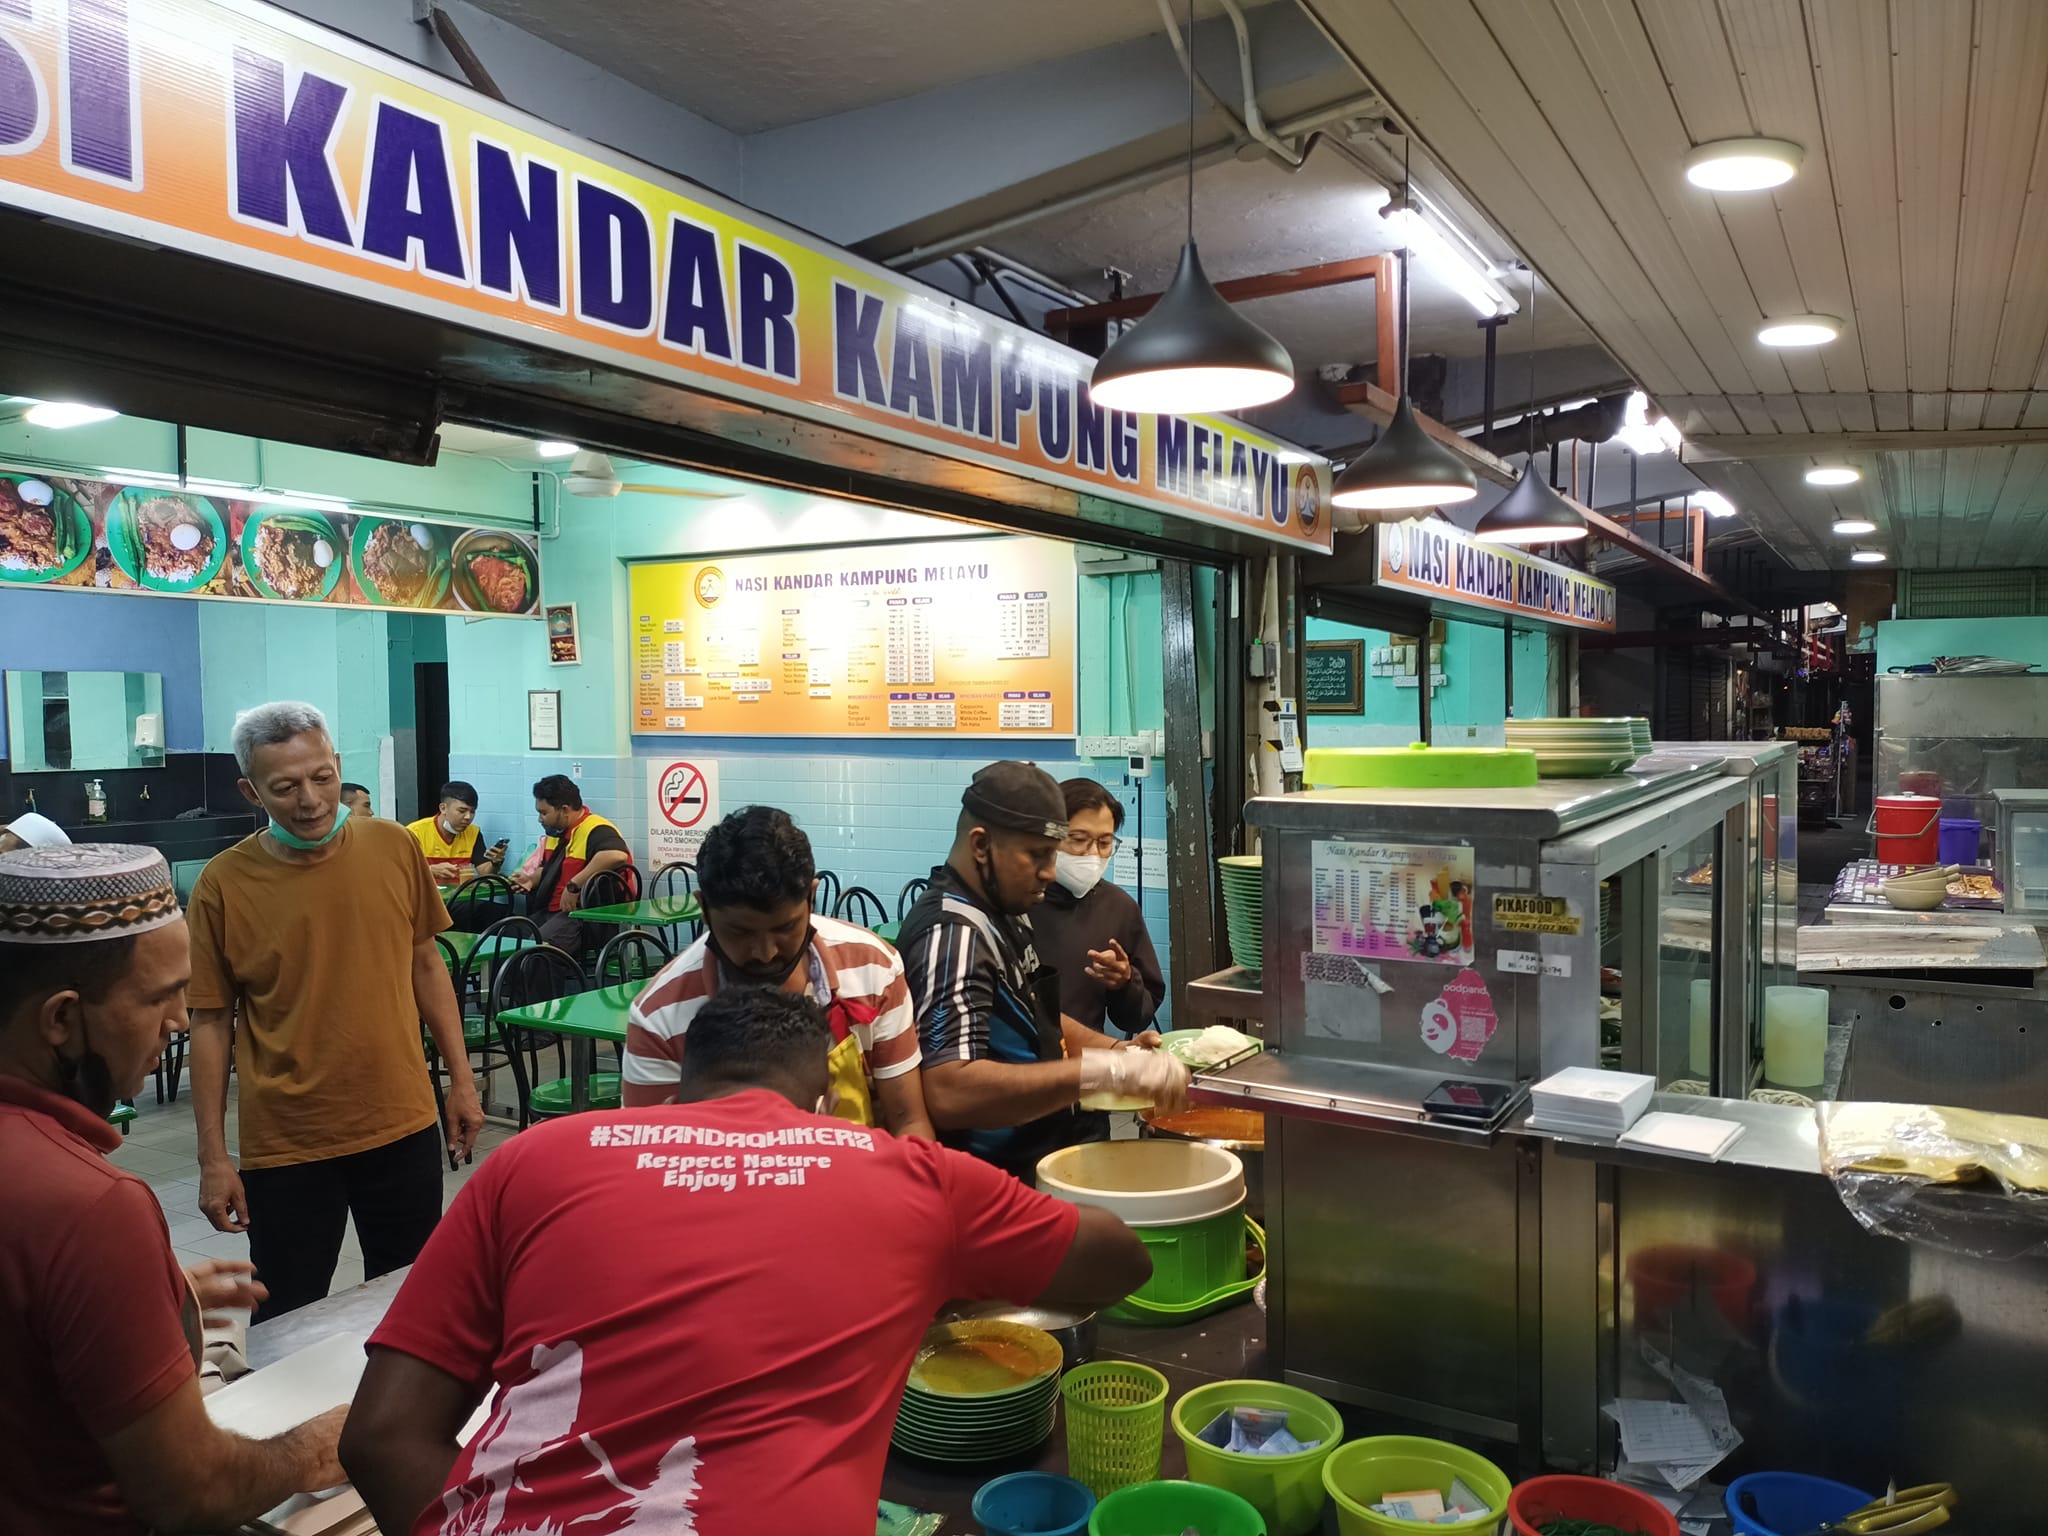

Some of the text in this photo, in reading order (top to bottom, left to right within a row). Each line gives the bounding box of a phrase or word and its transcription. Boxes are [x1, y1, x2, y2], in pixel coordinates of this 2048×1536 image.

[232, 44, 799, 381] KANDAR
[834, 282, 1139, 481] KAMPUNG
[1156, 411, 1289, 525] MELAYU
[735, 563, 989, 592] NASI KANDAR KAMPUNG MELAYU
[1408, 526, 1606, 623] NASI KANDAR KAMPUNG MELAYU
[650, 828, 683, 837] DILARANG
[1326, 845, 1346, 856] Nasi
[1347, 846, 1379, 858] Kandar
[1495, 898, 1553, 914] PIKAFOOD
[636, 1152, 832, 1173] Respect Nature
[663, 1168, 806, 1193] Enjoy Trail
